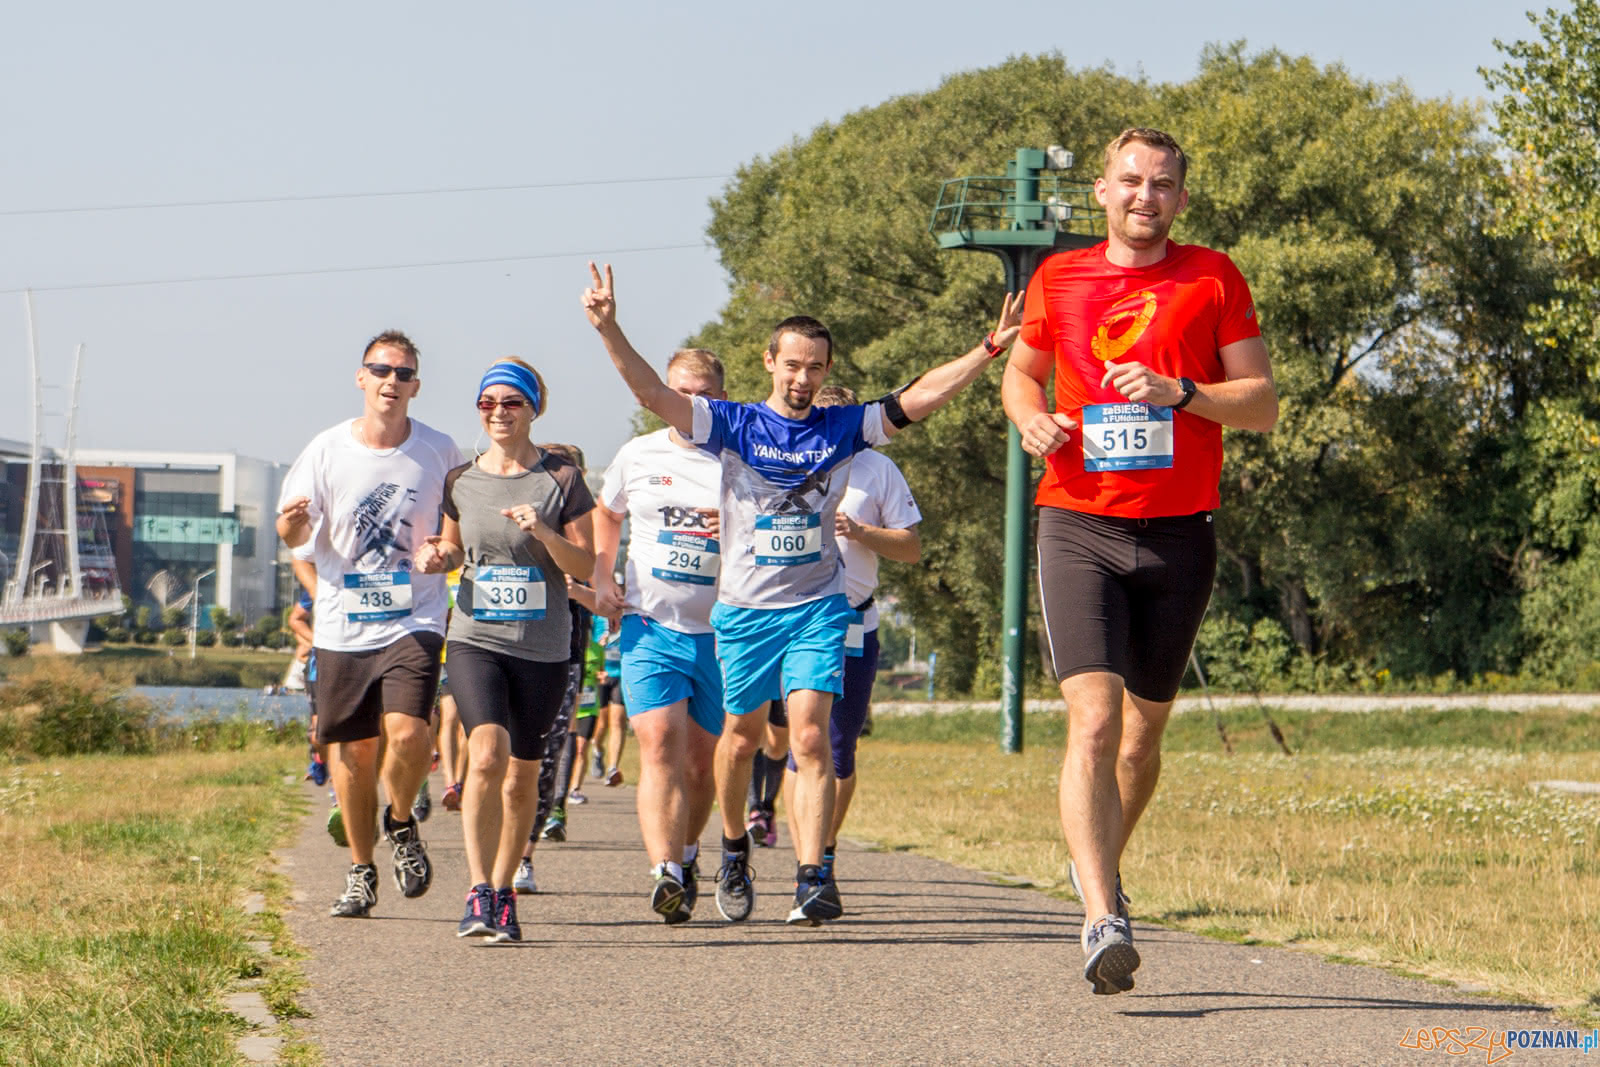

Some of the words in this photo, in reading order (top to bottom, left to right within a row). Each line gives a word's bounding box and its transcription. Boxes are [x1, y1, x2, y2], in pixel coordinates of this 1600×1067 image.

[1102, 404, 1149, 415] zaBIEGaj
[1103, 428, 1148, 451] 515
[771, 535, 805, 552] 060
[668, 551, 702, 570] 294
[360, 591, 393, 607] 438
[490, 587, 527, 605] 330
